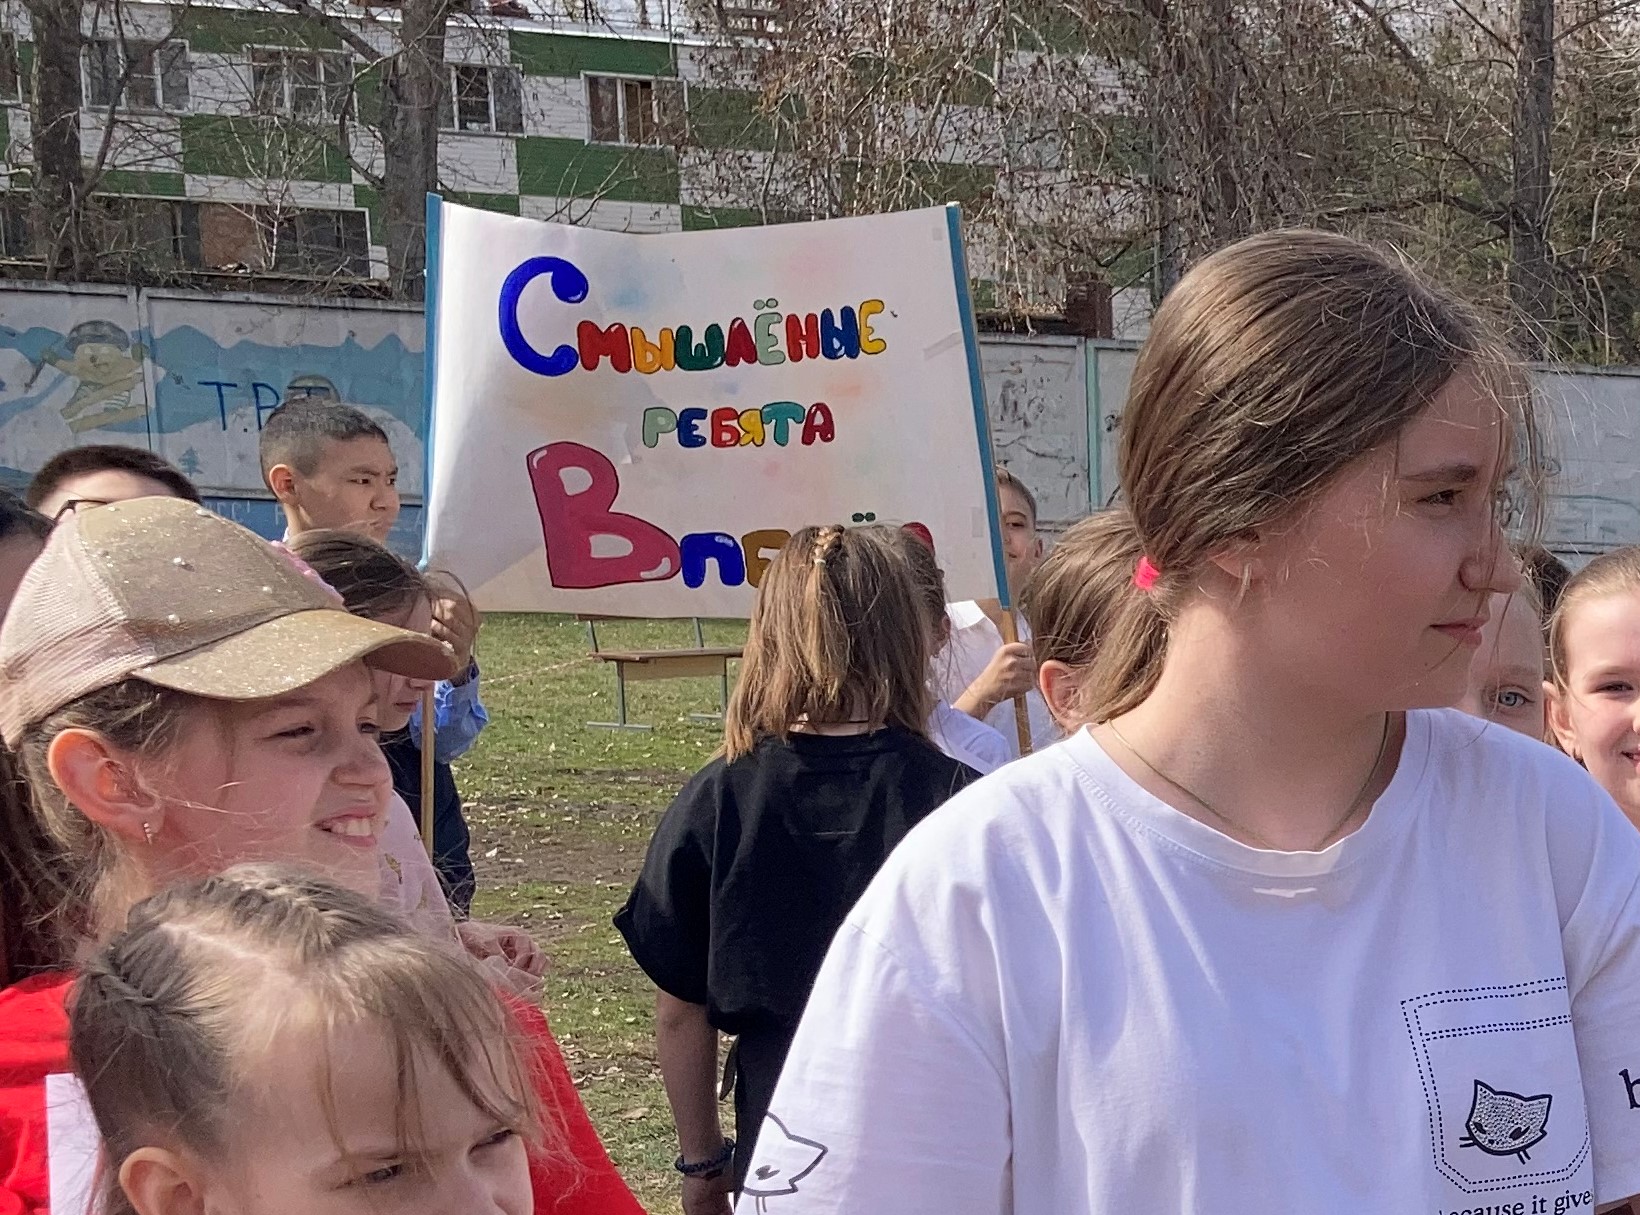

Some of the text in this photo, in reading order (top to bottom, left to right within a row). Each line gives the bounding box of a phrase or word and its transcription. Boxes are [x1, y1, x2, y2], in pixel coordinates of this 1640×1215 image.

[641, 401, 836, 449] РЕБЯТА
[526, 440, 936, 590] ВПЕ
[1531, 1195, 1547, 1214] it
